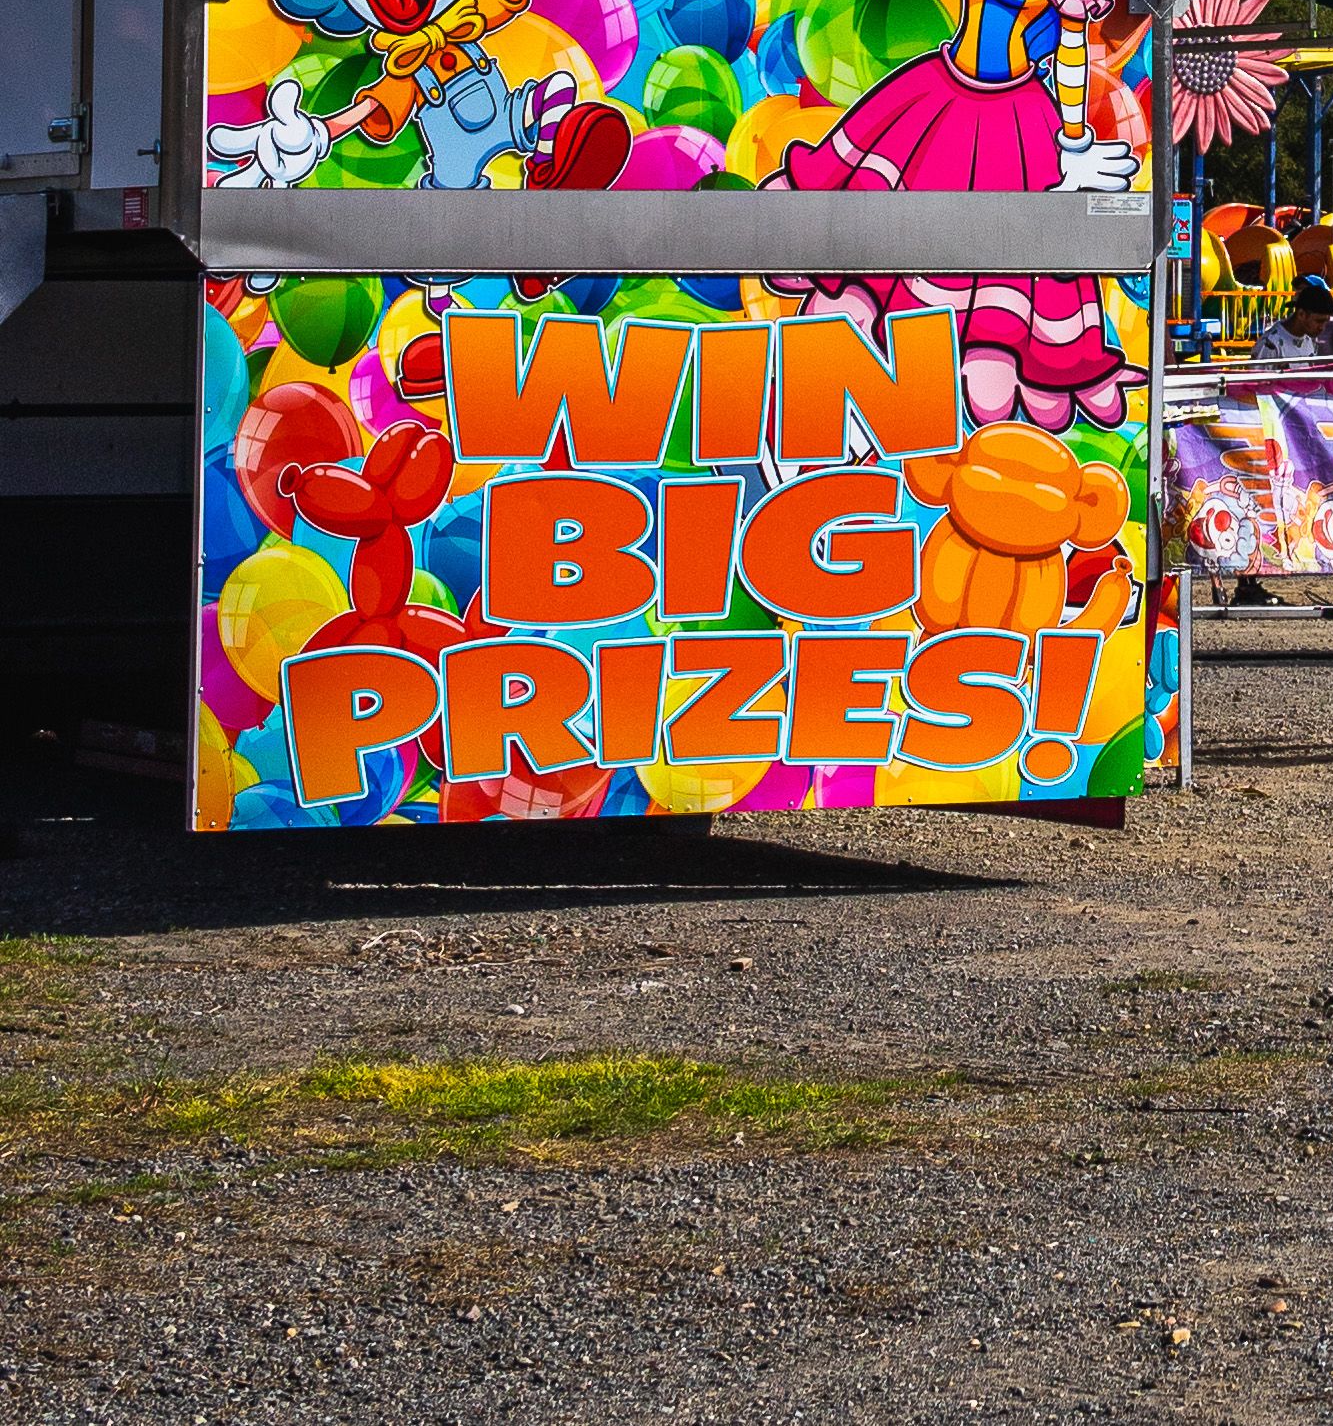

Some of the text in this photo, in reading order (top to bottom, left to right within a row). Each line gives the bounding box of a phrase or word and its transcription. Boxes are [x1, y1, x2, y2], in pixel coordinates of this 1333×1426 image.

[443, 305, 963, 468] WIN
[484, 468, 922, 628] BIG
[281, 628, 1104, 807] PRIZES!
